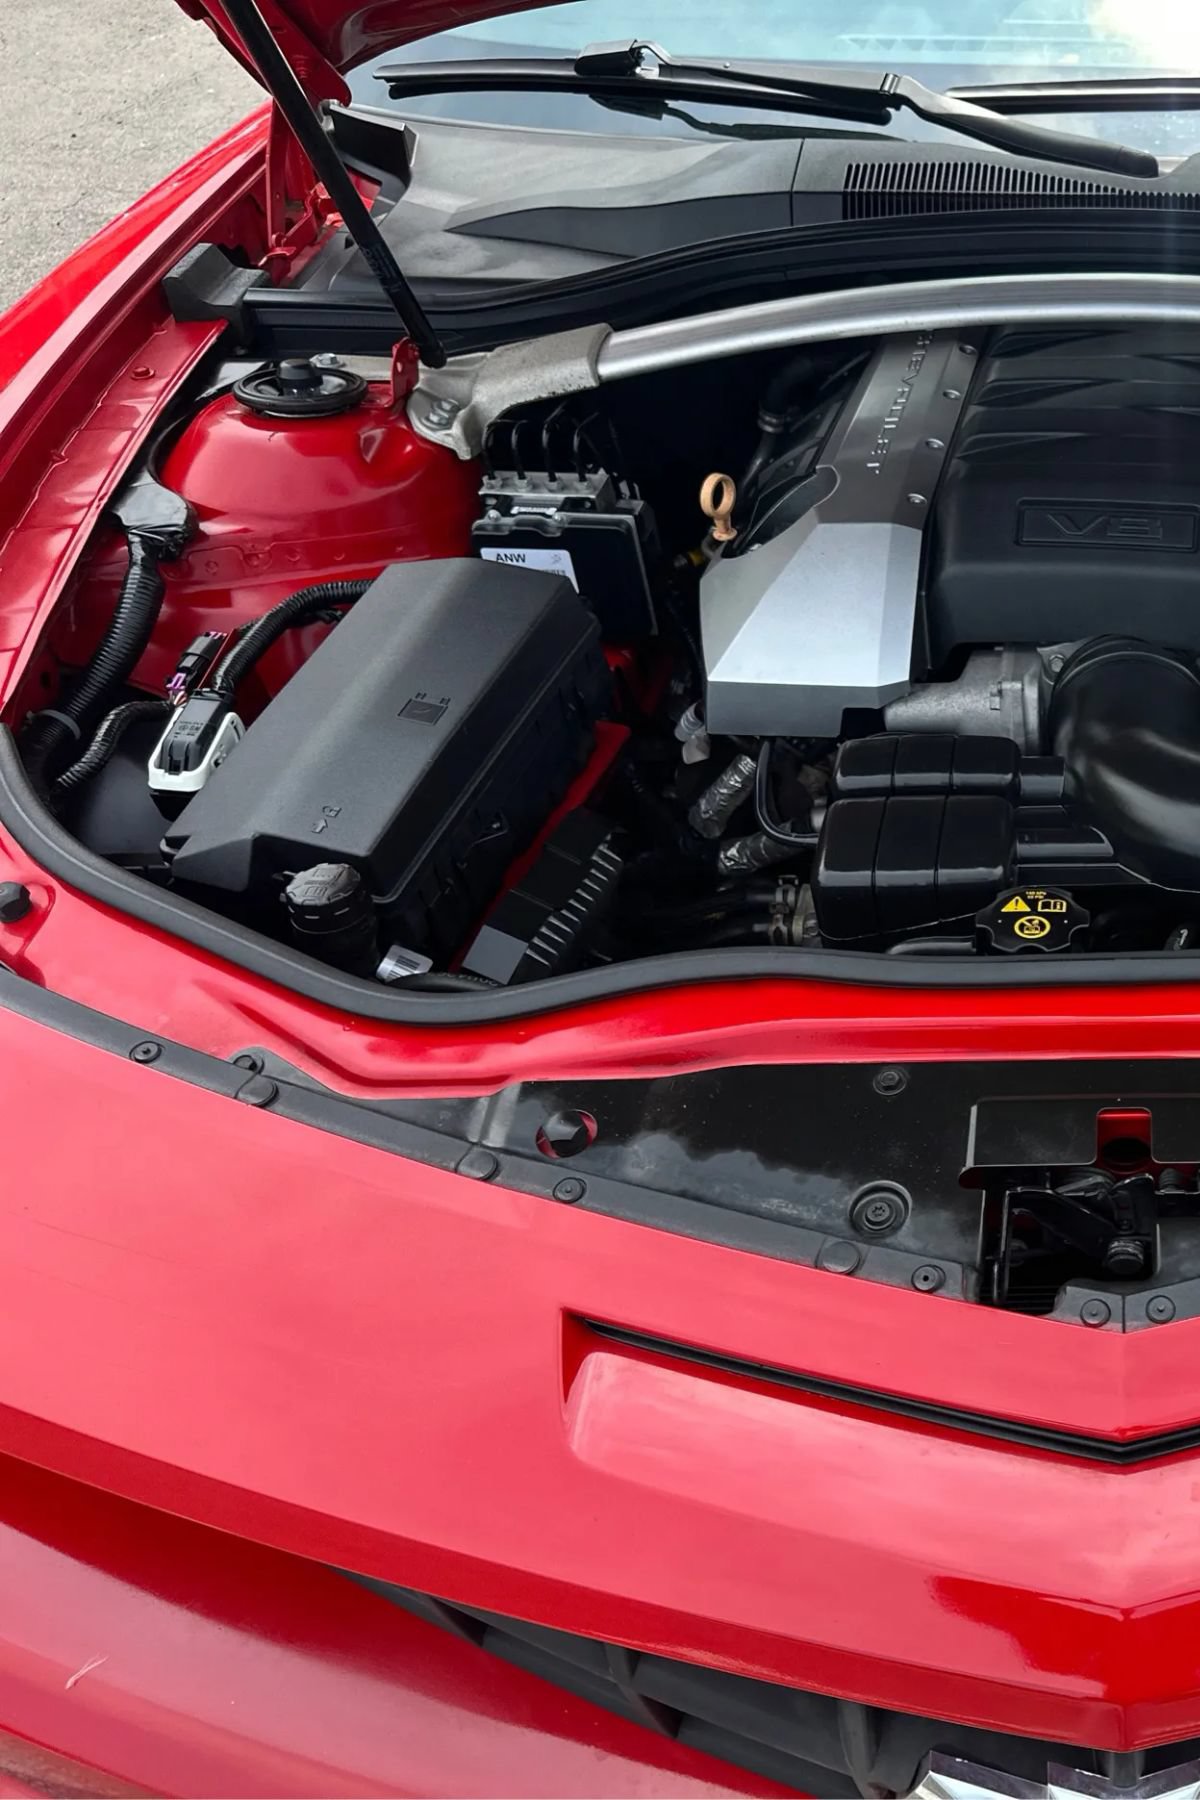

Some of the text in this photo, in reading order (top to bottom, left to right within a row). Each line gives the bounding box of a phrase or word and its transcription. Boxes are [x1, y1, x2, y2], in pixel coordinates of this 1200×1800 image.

[866, 329, 934, 475] HEVROLET
[1047, 512, 1163, 541] V8
[496, 553, 526, 563] ANW
